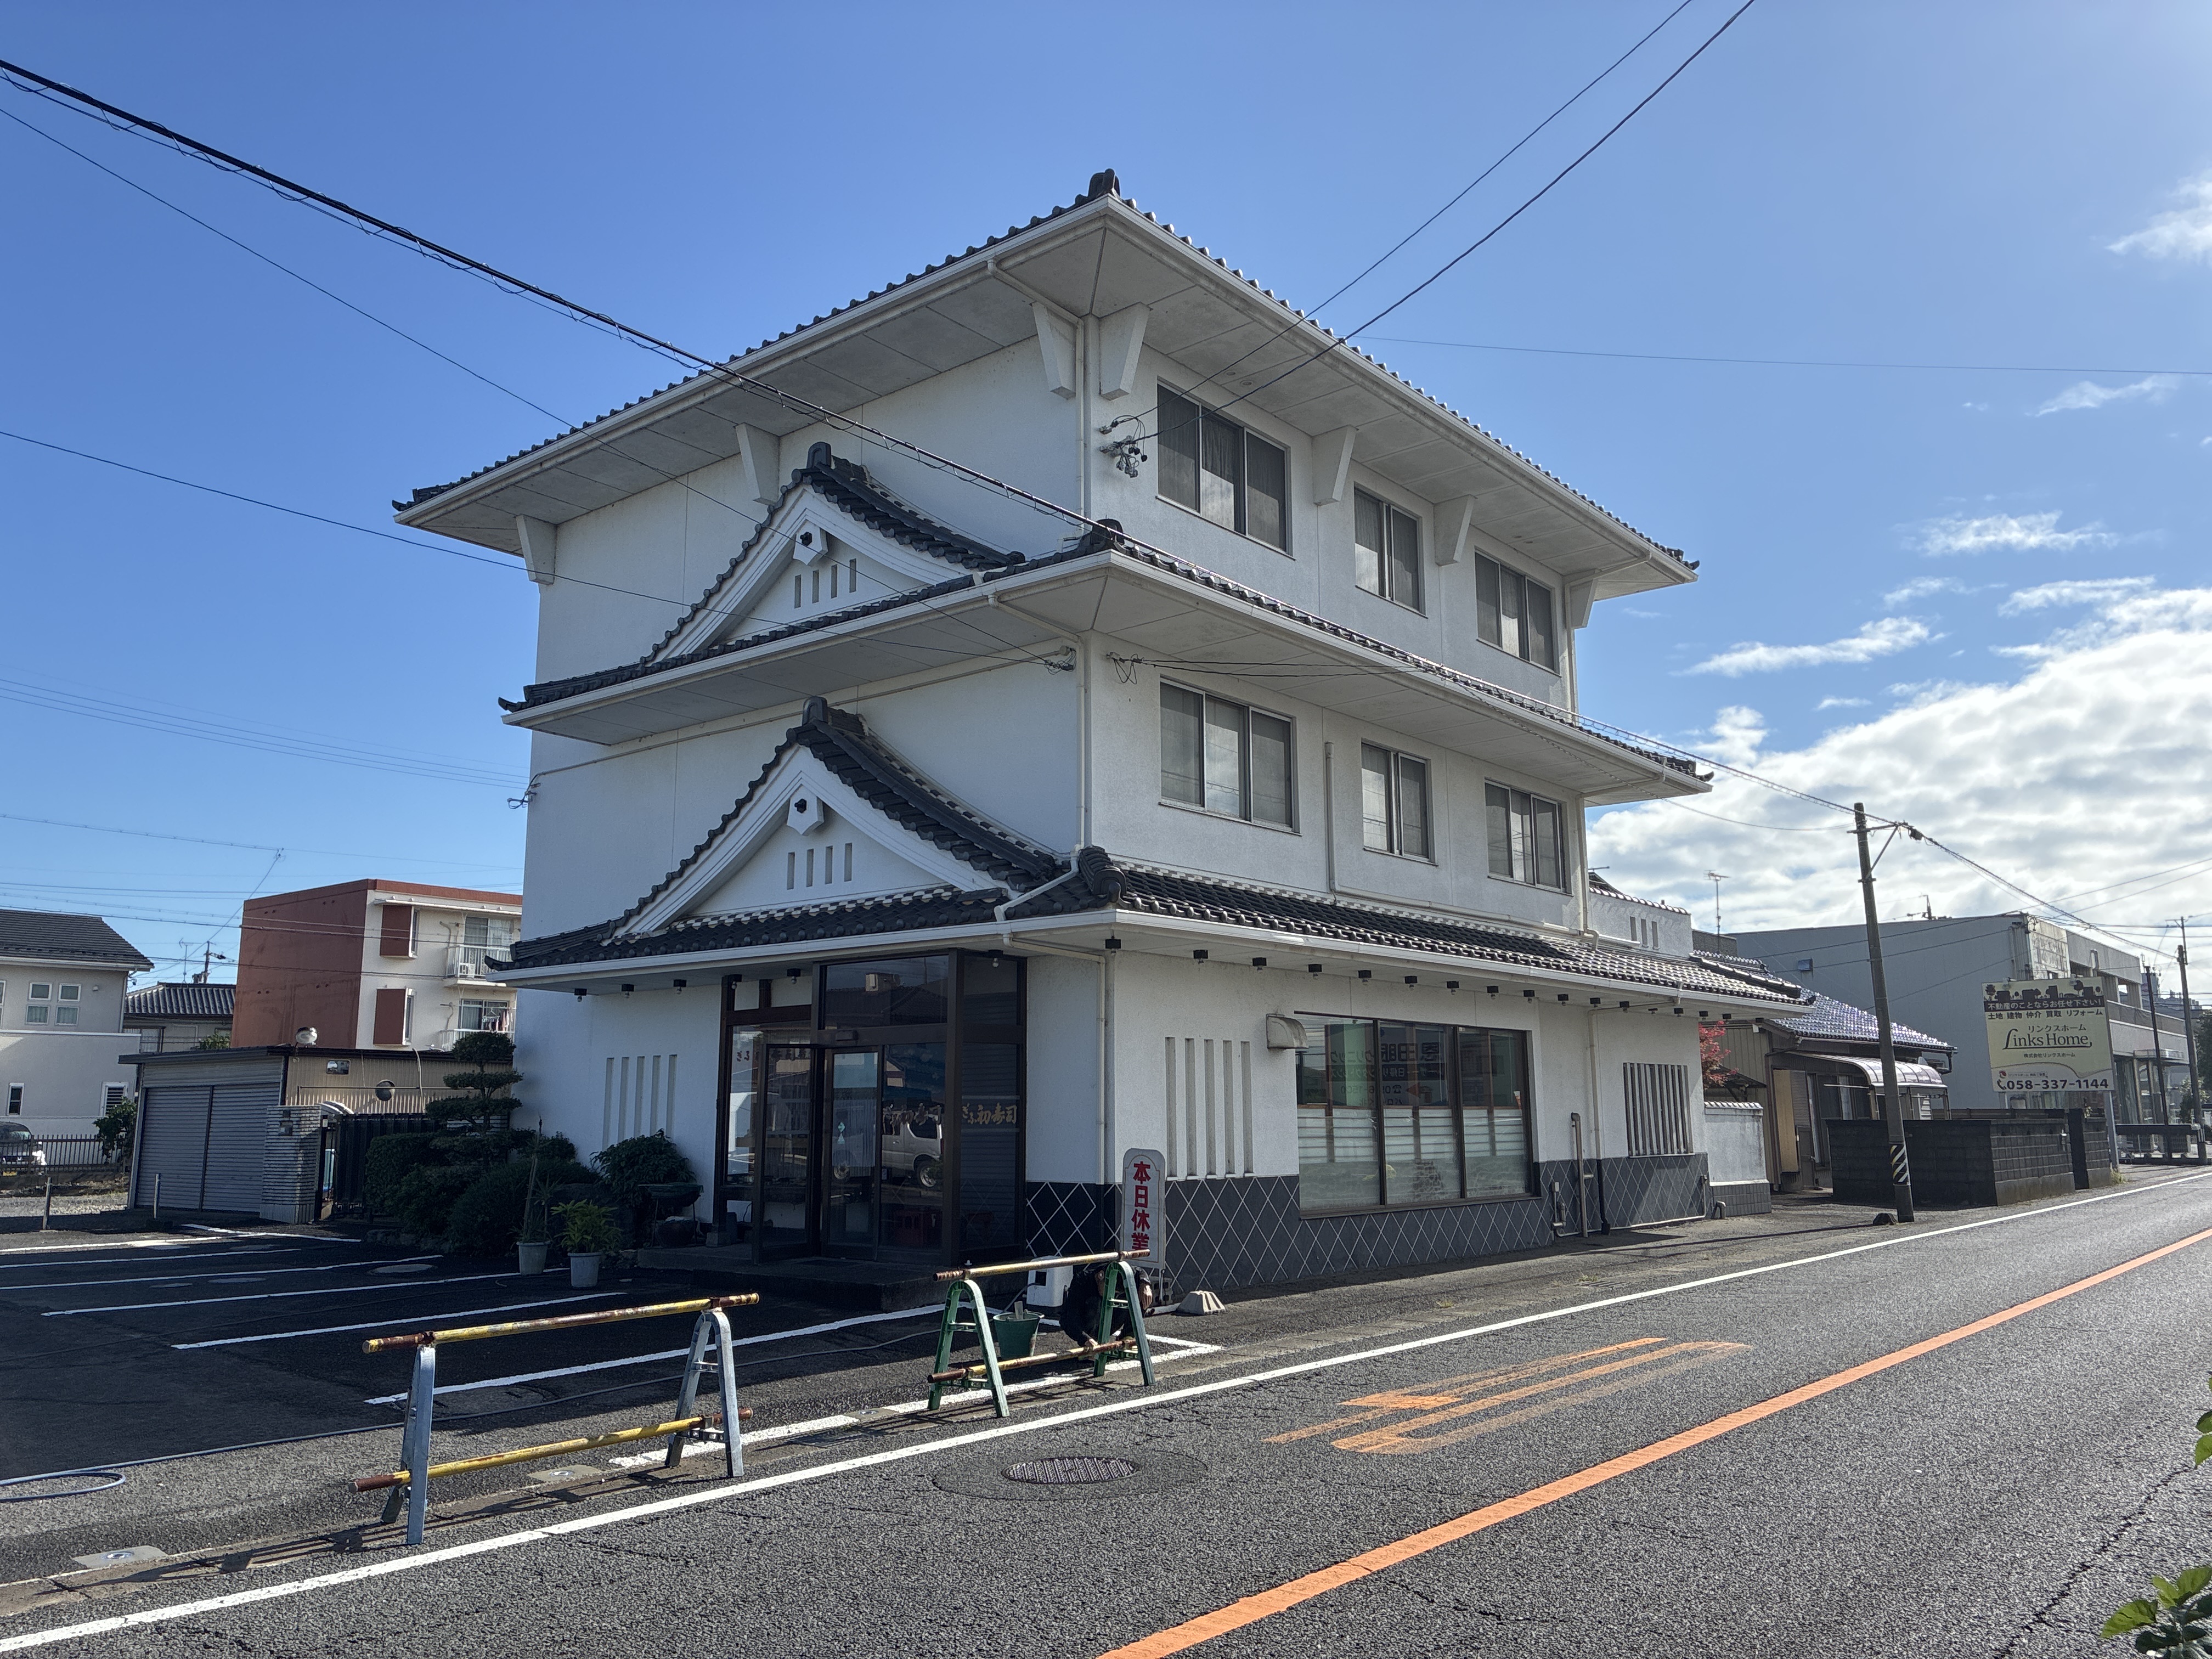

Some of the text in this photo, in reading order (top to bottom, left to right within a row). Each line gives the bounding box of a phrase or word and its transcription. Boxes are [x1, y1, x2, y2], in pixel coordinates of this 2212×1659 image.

[1987, 998, 2102, 1010] 不動産のことならお任せ下さい!
[2028, 1024, 2086, 1033] リンクスホーム
[2002, 1029, 2089, 1049] Links Home
[2006, 1079, 2109, 1090] 058-337-1144
[1131, 1161, 1152, 1251] 本日休業
